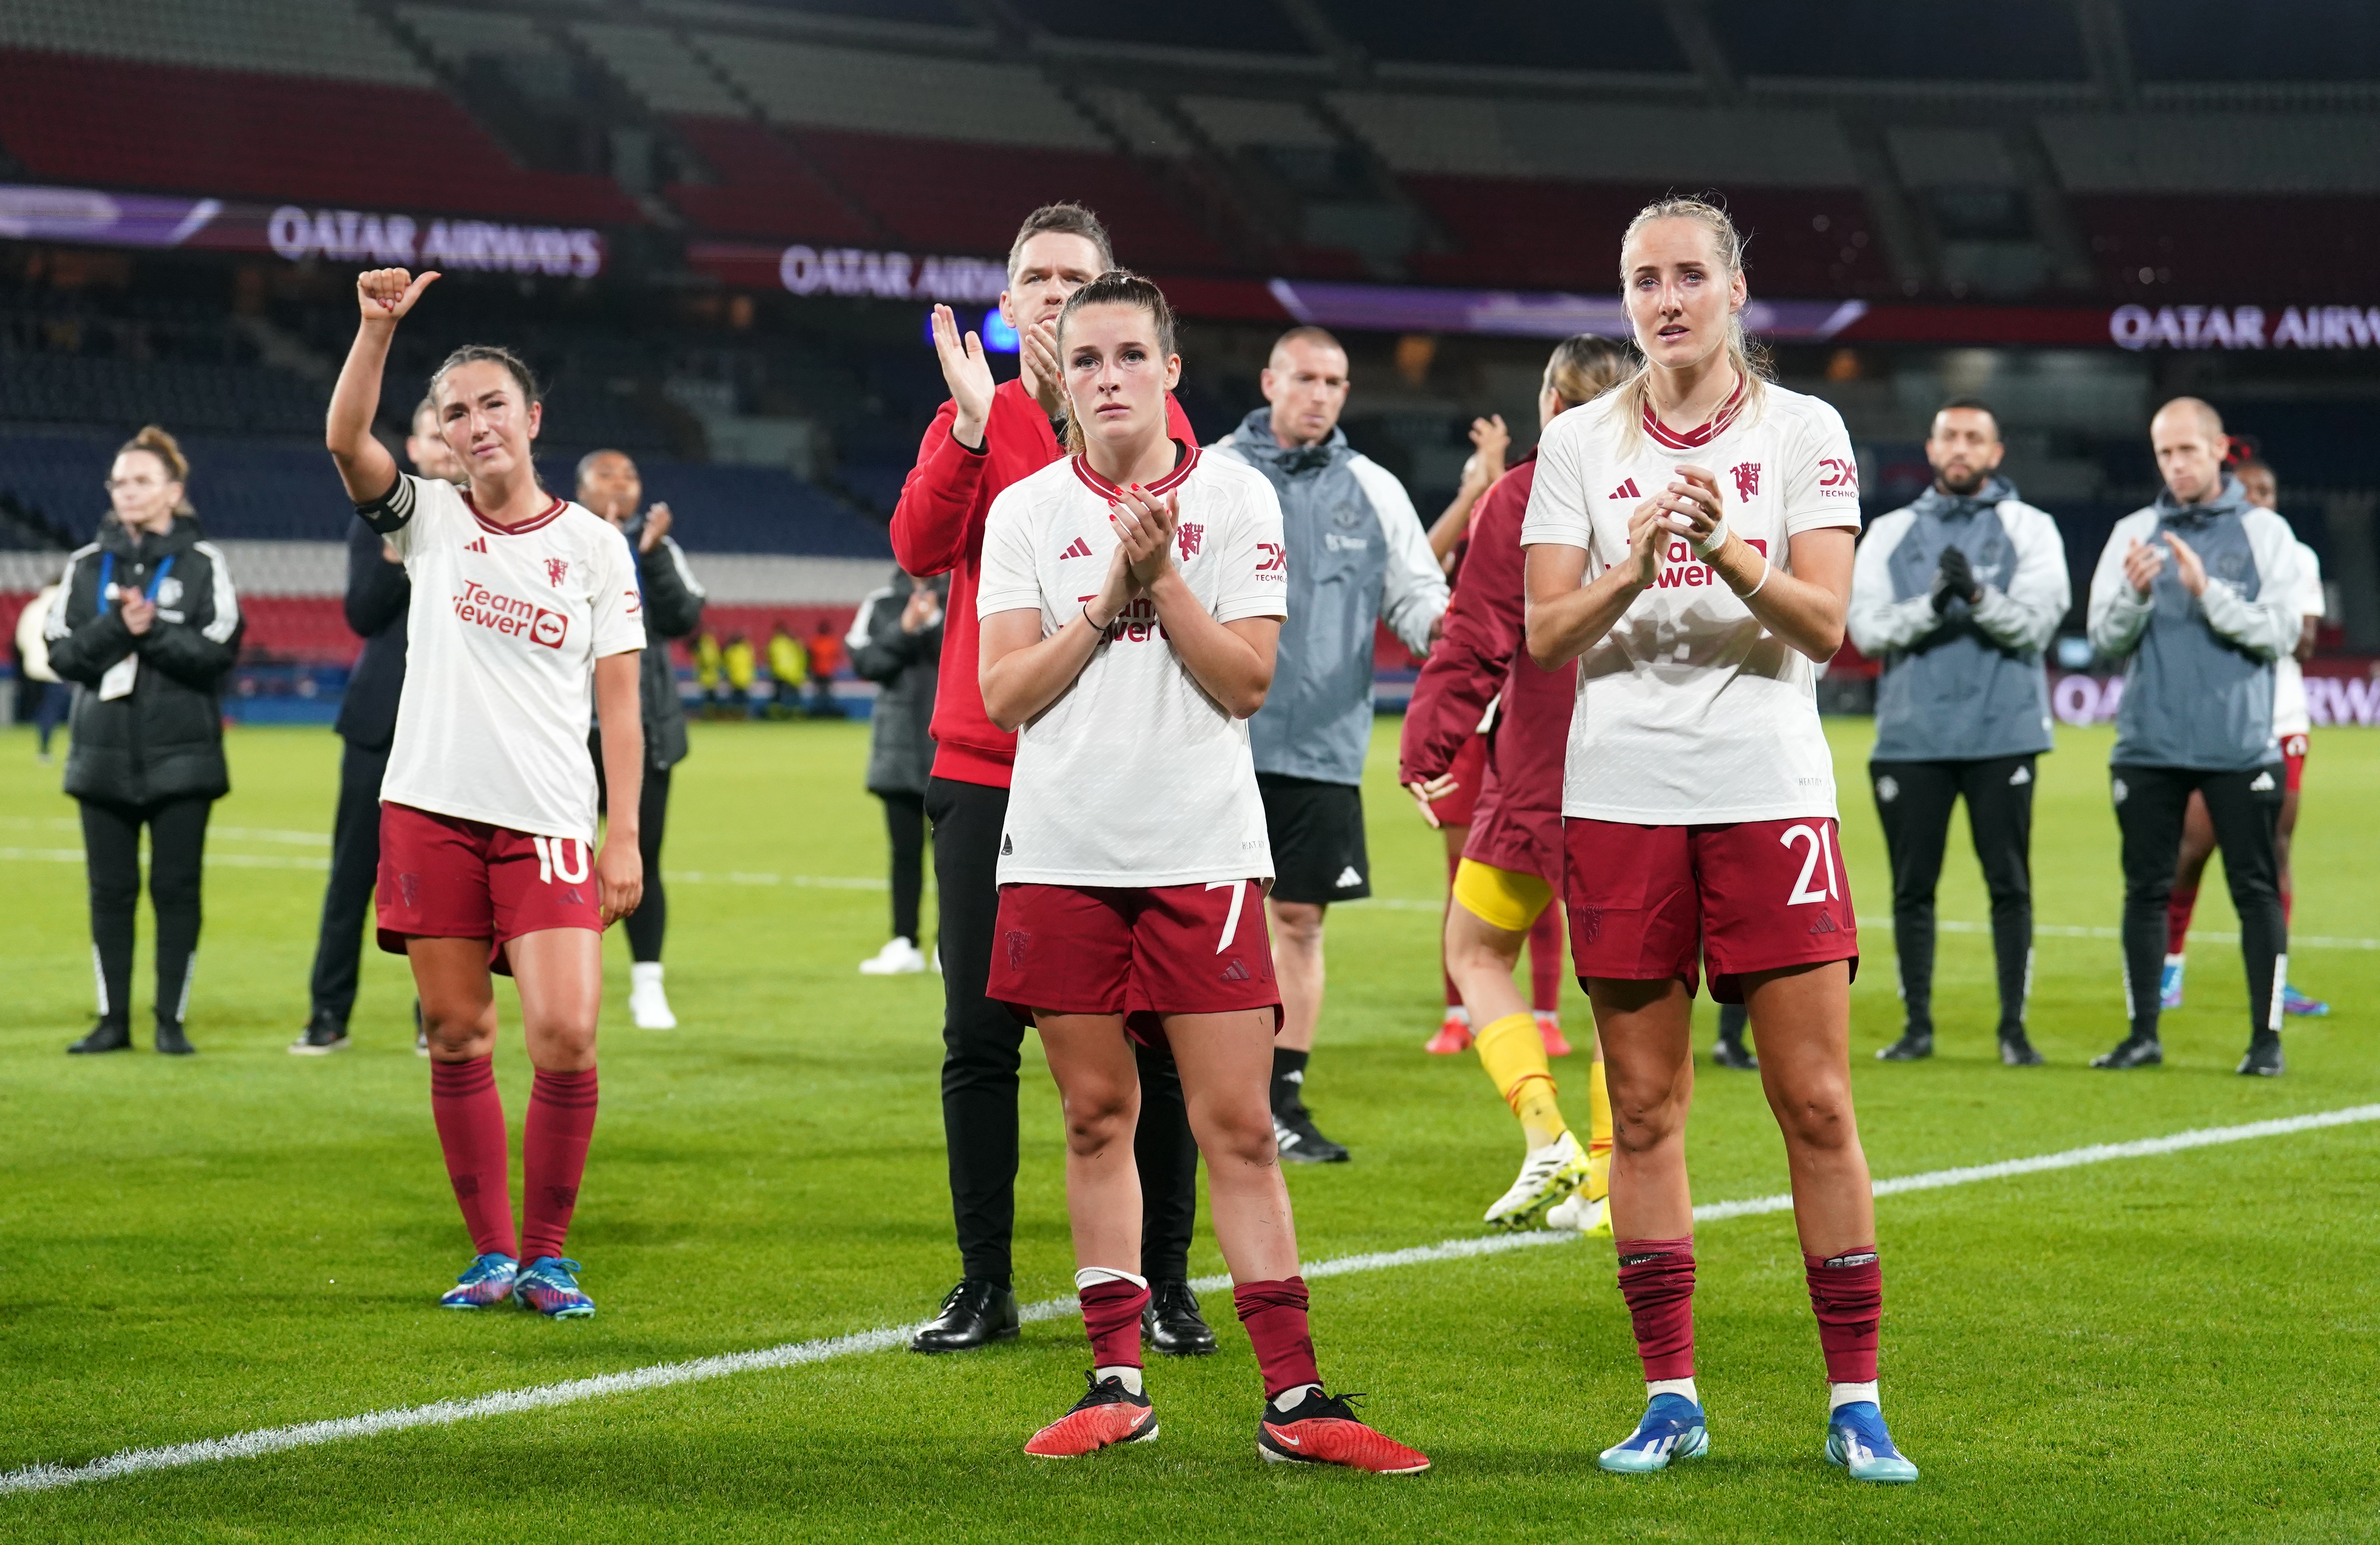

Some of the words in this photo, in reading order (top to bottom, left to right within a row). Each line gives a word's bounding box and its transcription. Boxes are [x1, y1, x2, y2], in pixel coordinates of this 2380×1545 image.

[2109, 304, 2265, 351] QATAR
[2272, 304, 2380, 349] AIRW
[464, 579, 533, 619] Team
[532, 836, 589, 884] 10
[1780, 820, 1839, 906] 21
[1204, 879, 1247, 956] 7
